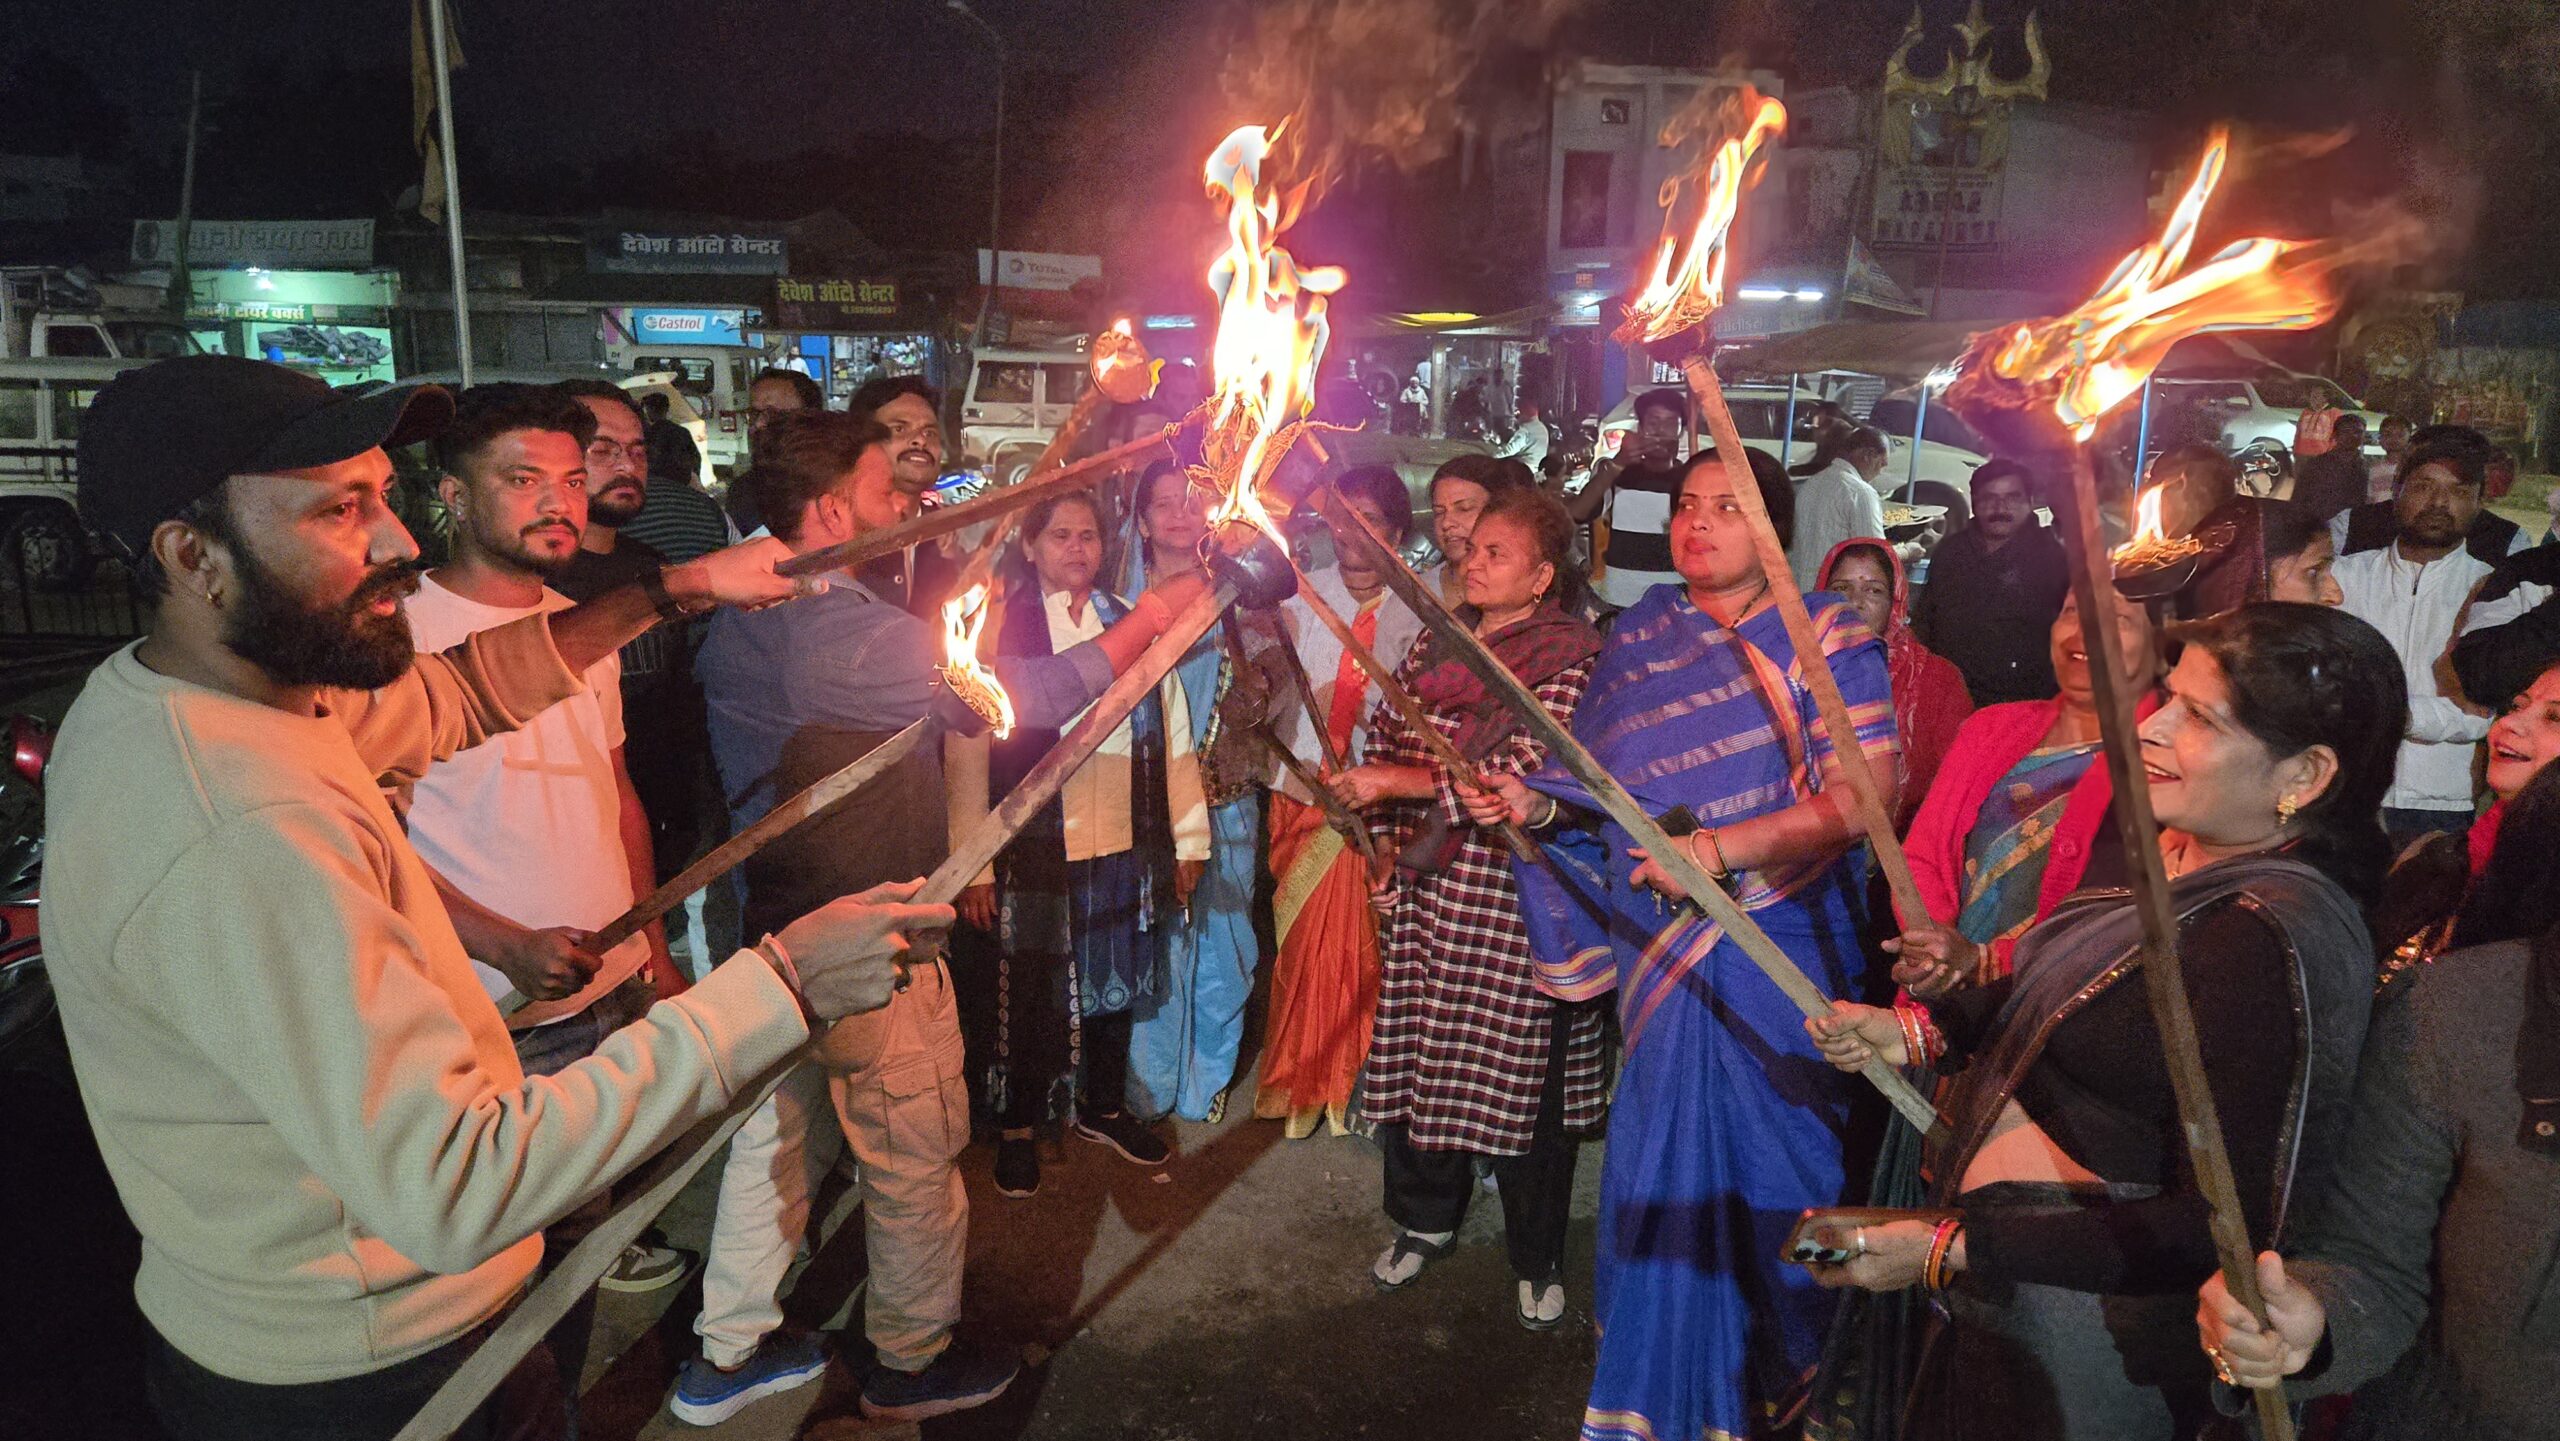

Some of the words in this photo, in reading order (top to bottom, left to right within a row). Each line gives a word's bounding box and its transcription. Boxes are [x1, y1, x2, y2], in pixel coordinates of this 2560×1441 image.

[621, 232, 671, 254] देवेश
[731, 233, 782, 255] सेन्टर
[1028, 262, 1069, 275] TOTAL
[777, 279, 815, 302] देवेश
[859, 279, 896, 302] सेन्टर
[658, 316, 701, 329] Castrol
